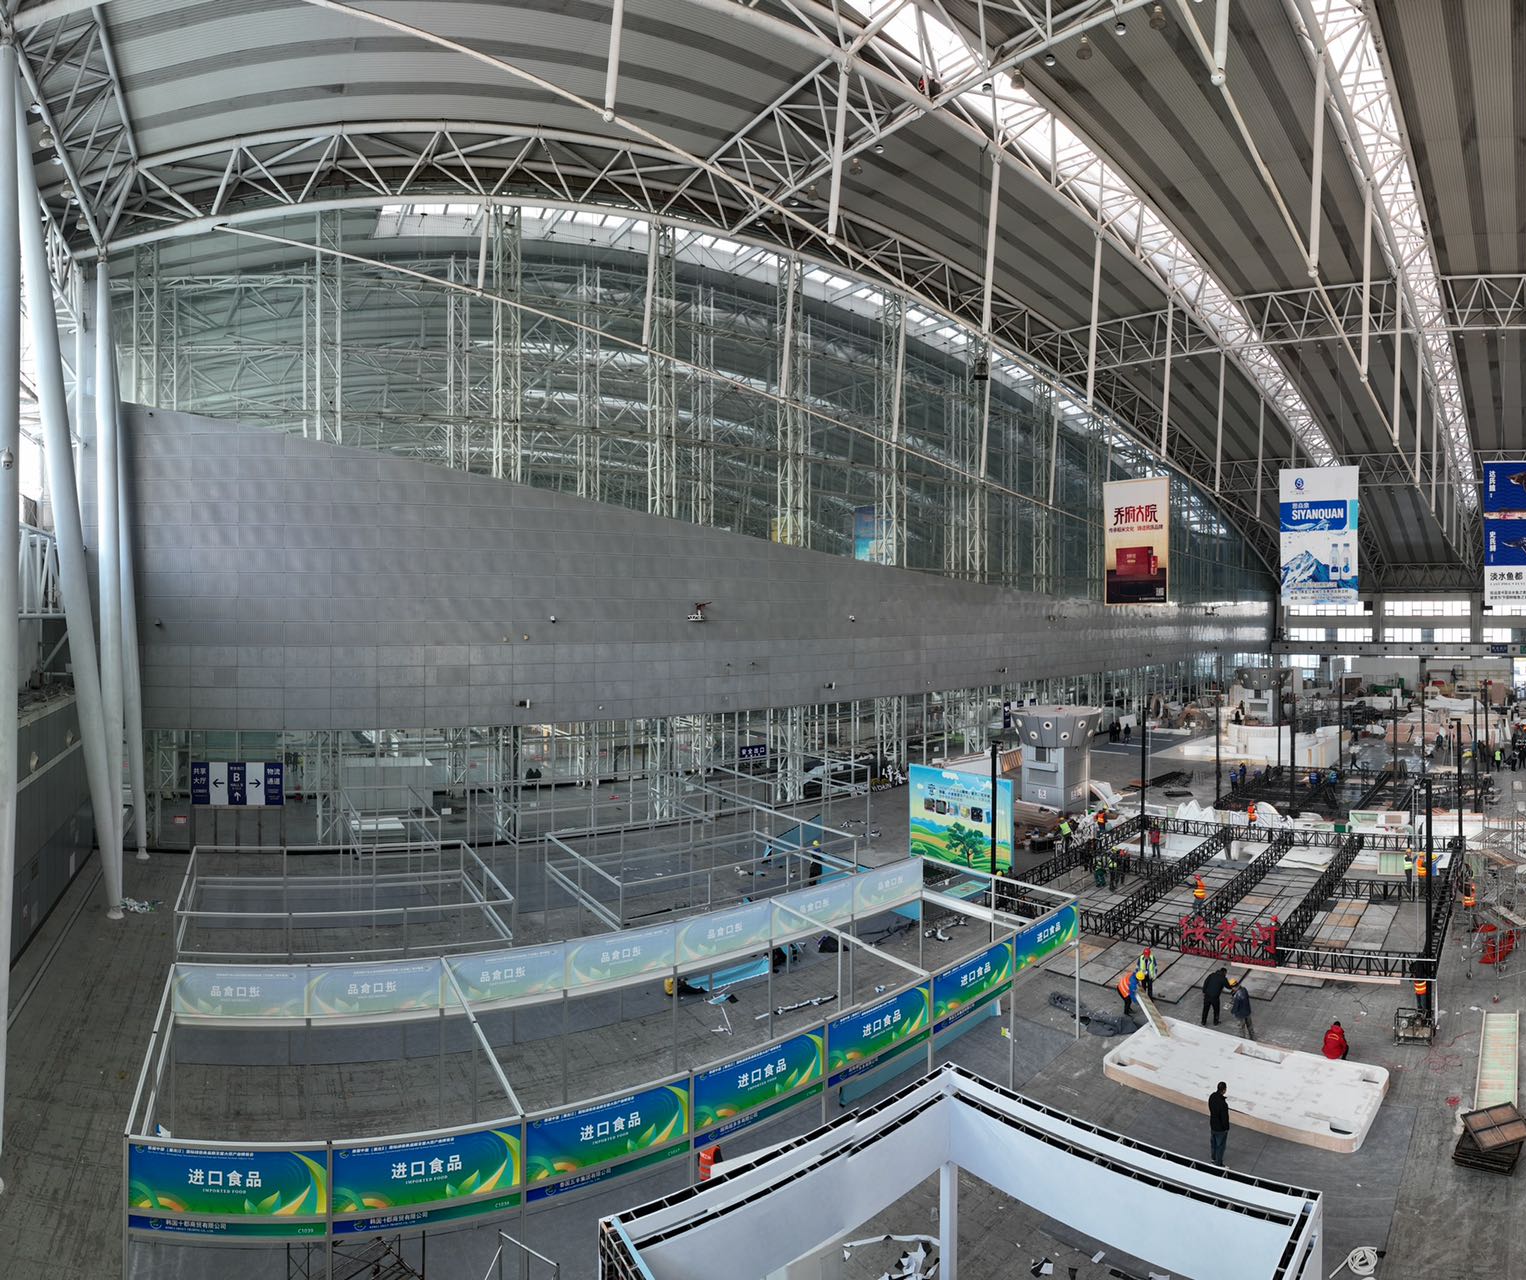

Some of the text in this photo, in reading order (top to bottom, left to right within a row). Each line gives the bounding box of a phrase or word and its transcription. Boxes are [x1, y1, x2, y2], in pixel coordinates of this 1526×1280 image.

[1113, 504, 1158, 526] 乔府大院
[1292, 508, 1344, 520] SIYANQUAN
[1490, 572, 1523, 580] 淡水鱼都
[233, 773, 240, 782] B
[1179, 914, 1280, 954] 绥芬河
[960, 962, 991, 987] 进口食品
[863, 1009, 901, 1037] 进口食品
[738, 1058, 786, 1089] 进口食品
[580, 1111, 641, 1142] 进口食品
[188, 1168, 262, 1188] 进口食品
[391, 1155, 462, 1180] 进口食品
